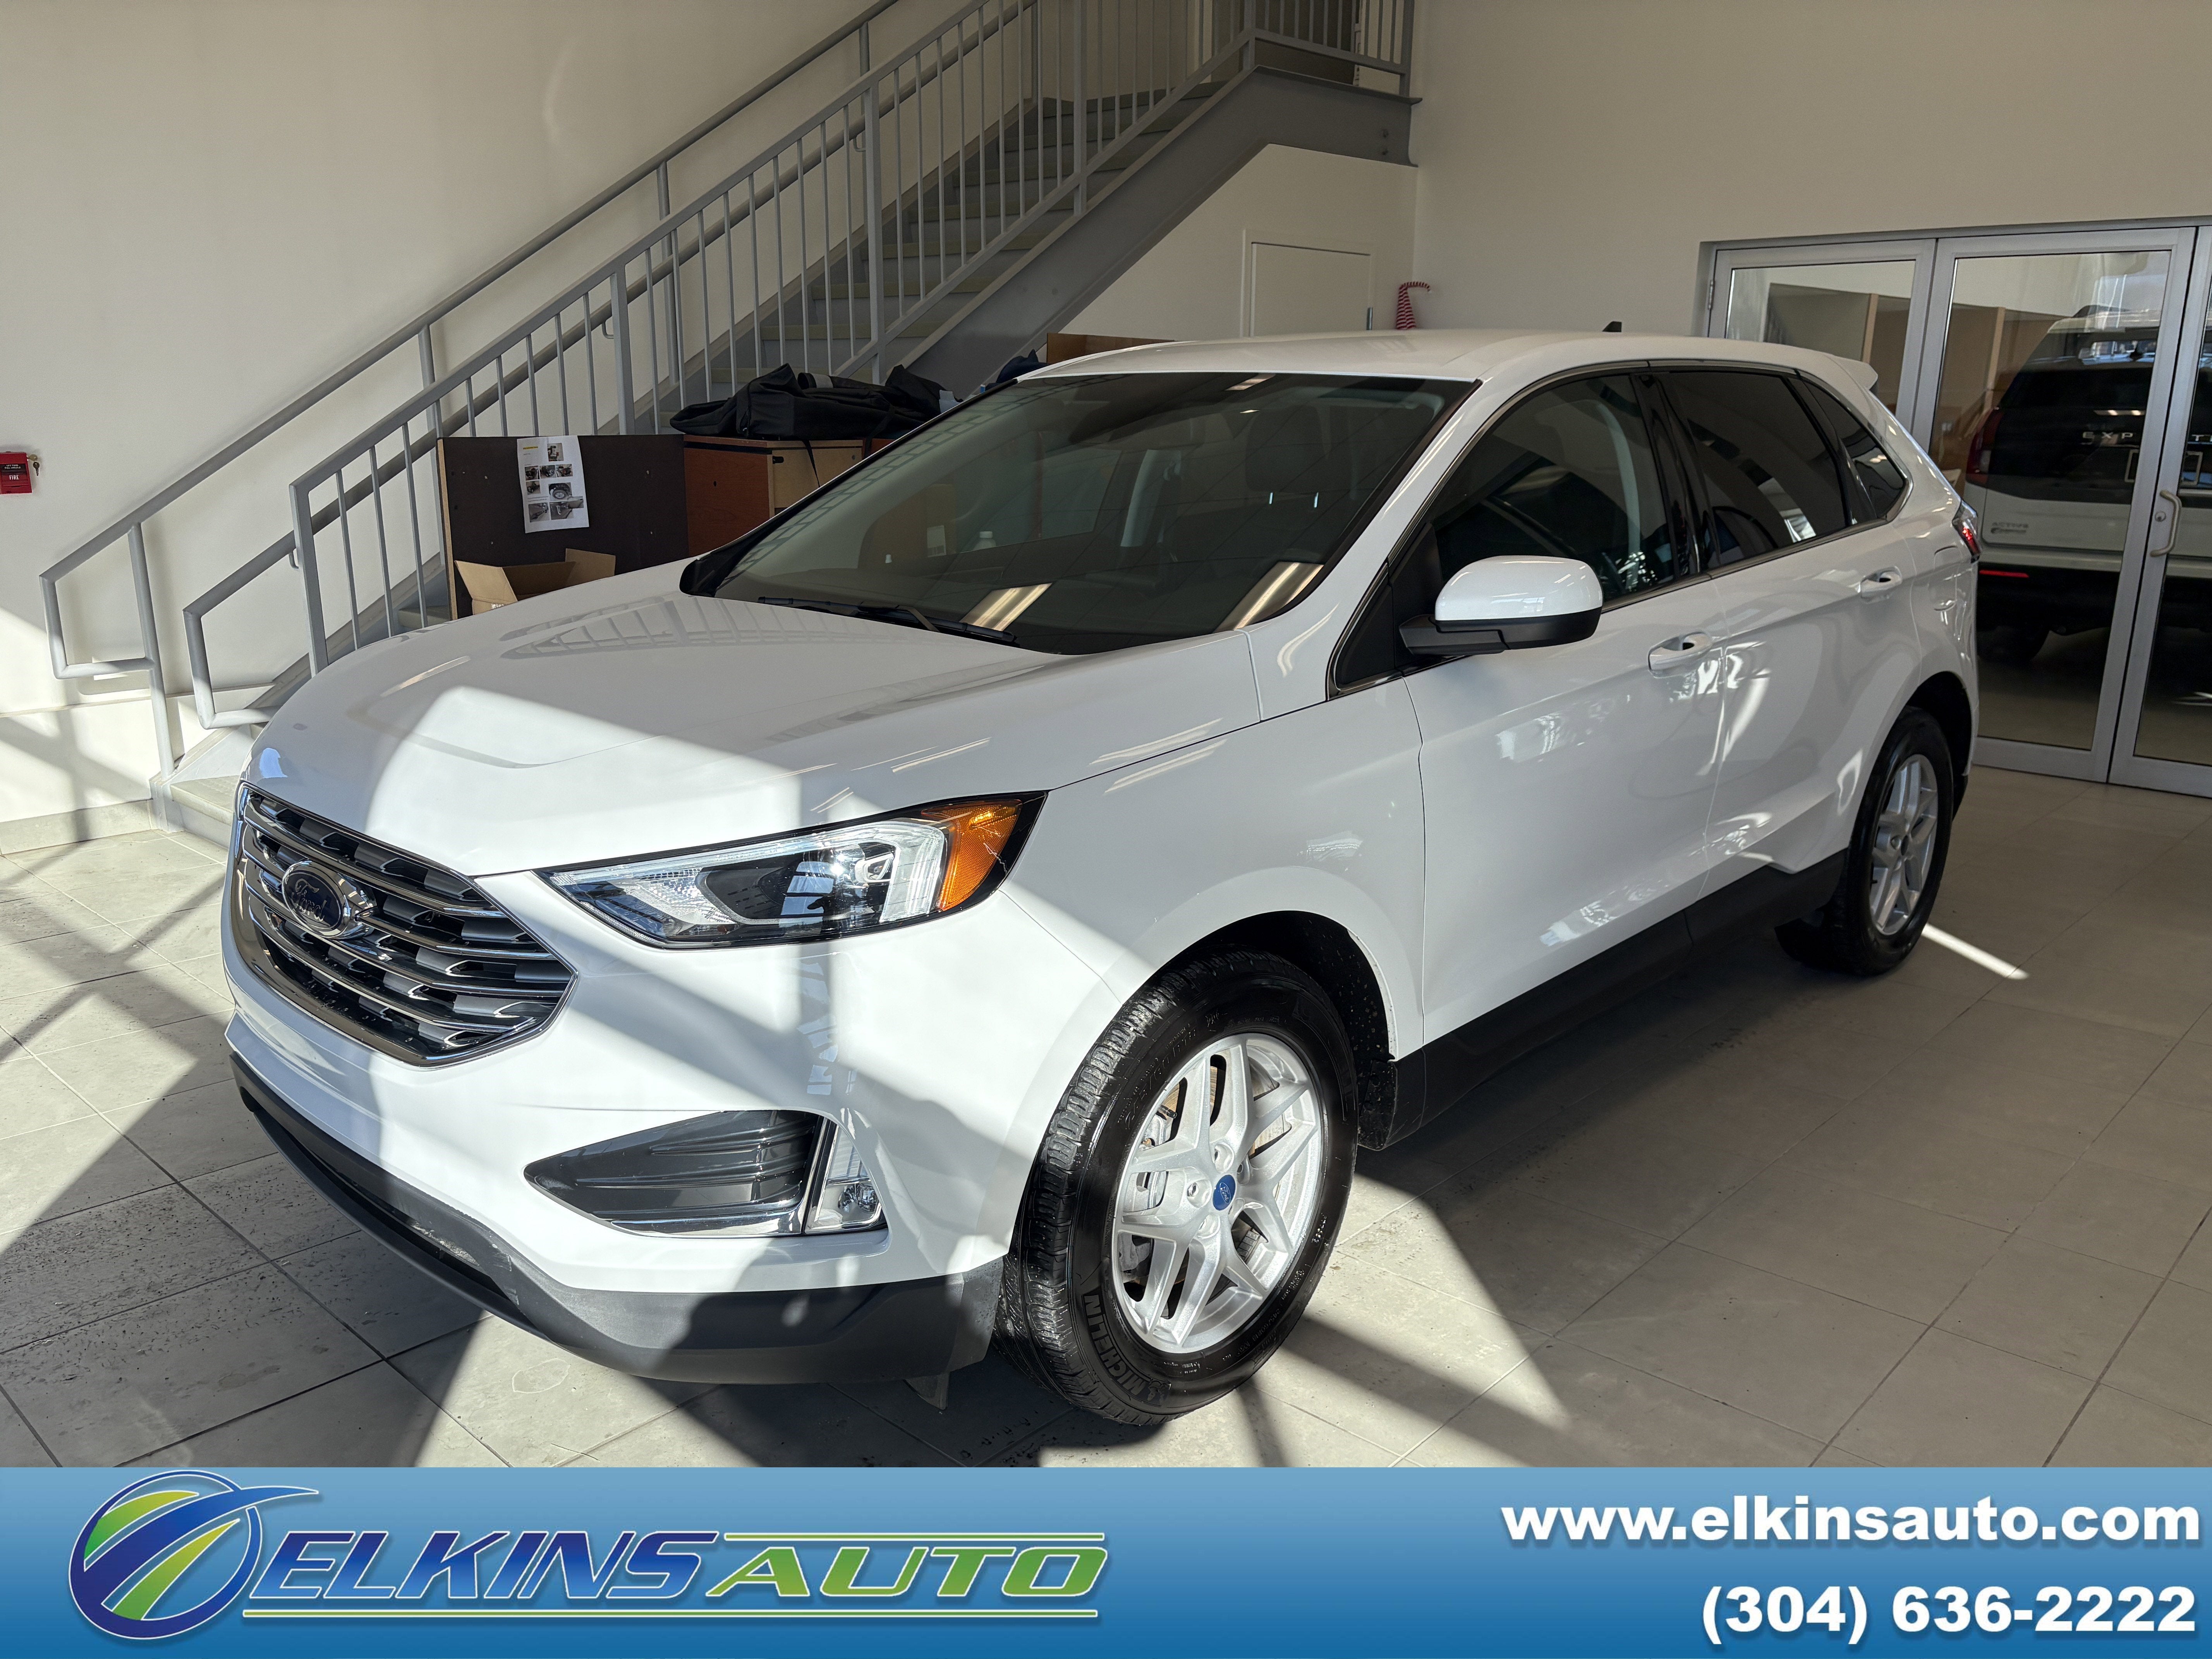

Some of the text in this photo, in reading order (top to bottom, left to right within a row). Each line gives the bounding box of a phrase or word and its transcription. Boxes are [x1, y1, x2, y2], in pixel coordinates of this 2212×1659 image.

[291, 879, 327, 922] Ford
[1220, 1186, 1230, 1201] Ford
[1084, 1294, 1147, 1395] MICHELIN
